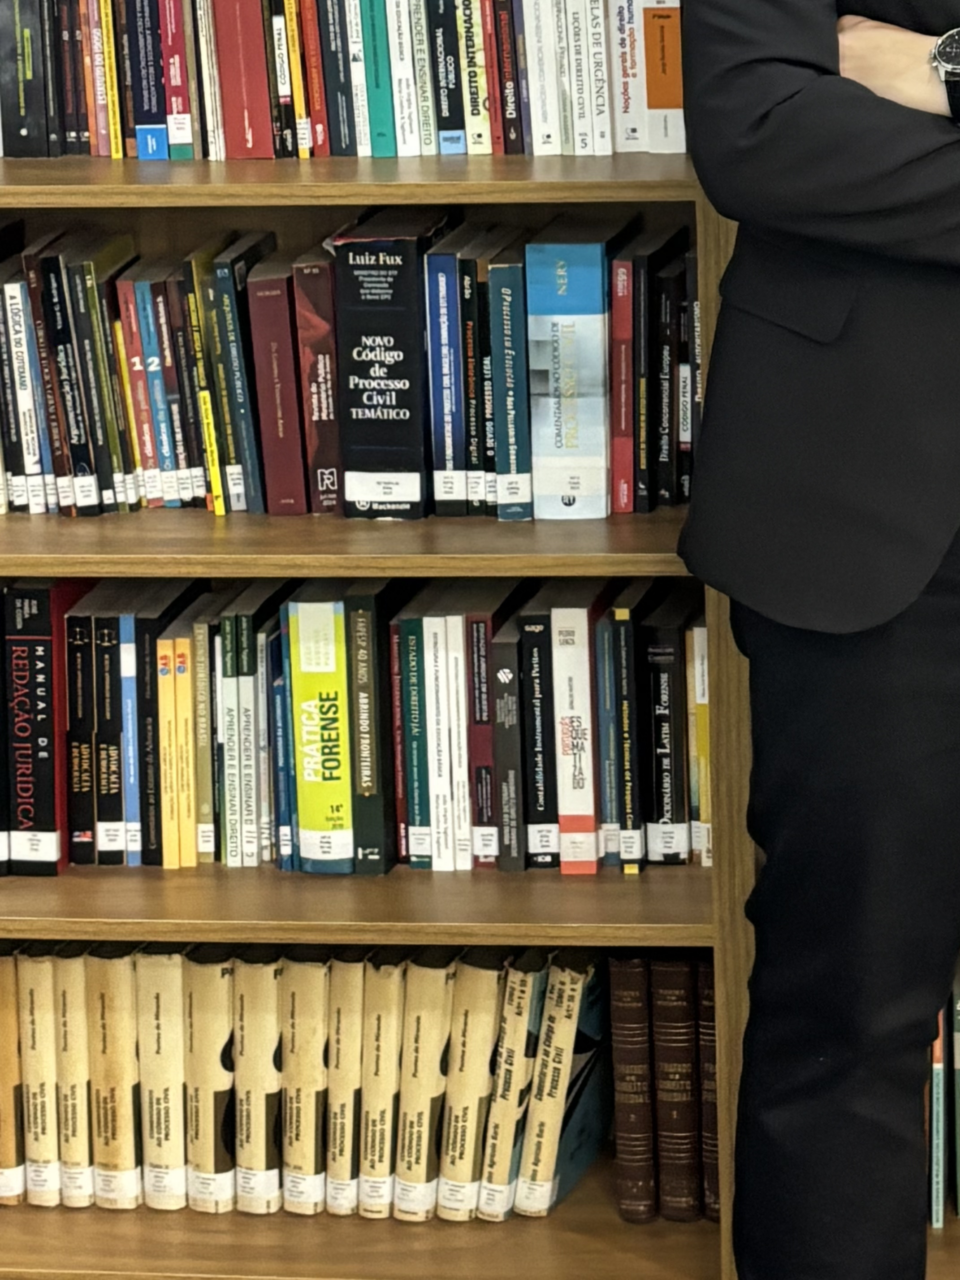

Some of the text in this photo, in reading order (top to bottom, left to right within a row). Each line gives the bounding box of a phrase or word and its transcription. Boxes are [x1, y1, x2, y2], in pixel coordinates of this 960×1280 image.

[592, 31, 602, 47] DE
[616, 5, 631, 114] Noções gerais de direito
[417, 58, 429, 103] ENSINAR
[466, 70, 481, 117] DIREITO
[593, 49, 607, 117] URGÊNCIA
[503, 82, 516, 119] Direito
[420, 105, 433, 146] DIREITO
[580, 138, 588, 149] 5
[348, 252, 403, 265] Luiz Fux
[556, 257, 569, 296] NERY
[352, 347, 404, 364] Código
[361, 335, 394, 347] NOVO
[131, 357, 143, 371] 1
[147, 357, 161, 371] 2
[349, 376, 410, 390] Processo
[370, 364, 388, 377] de
[350, 406, 410, 420] TEMÁTICO
[362, 391, 397, 406] Civil
[35, 645, 48, 759] MANUAL DE
[10, 645, 35, 830] REDAÇÃO JURÍDICA
[225, 707, 236, 760] APRENDER
[300, 699, 320, 782] PRÁTICA
[319, 690, 341, 782] FORENSE
[358, 691, 372, 787] ABRINDO FRONTEIRAS
[227, 773, 237, 815] ENSINAR
[228, 819, 239, 858] DIREITO
